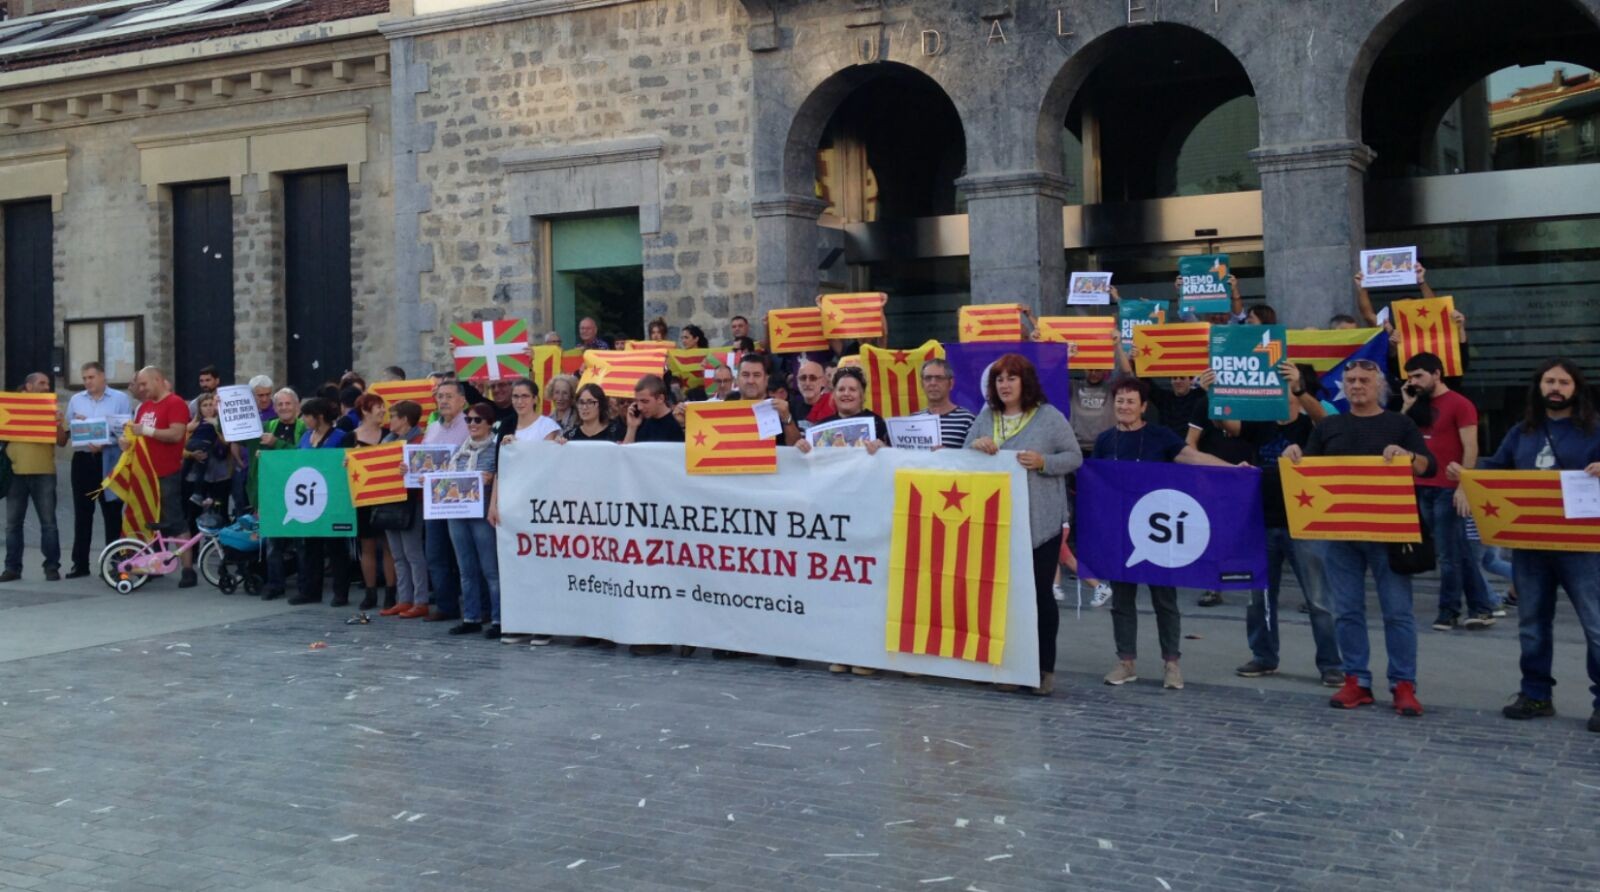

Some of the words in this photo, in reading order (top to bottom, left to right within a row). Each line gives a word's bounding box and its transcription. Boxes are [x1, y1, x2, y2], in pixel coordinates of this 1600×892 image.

[1182, 275, 1214, 286] DEMO
[1182, 284, 1226, 295] KRAZIA
[1212, 356, 1260, 371] DEMO
[1214, 371, 1280, 386] KRAZIA
[224, 399, 251, 407] VOTEM
[897, 436, 932, 444] VOTEM
[294, 482, 317, 506] Sí
[530, 499, 777, 536] KATALUNIAREKIN
[787, 511, 850, 542] BAT
[1148, 511, 1189, 545] Sí
[516, 533, 797, 577] DEMOKRAZIAREKIN
[807, 552, 876, 585] BAT
[567, 574, 672, 600] Referéndum
[691, 584, 805, 615] democracia
